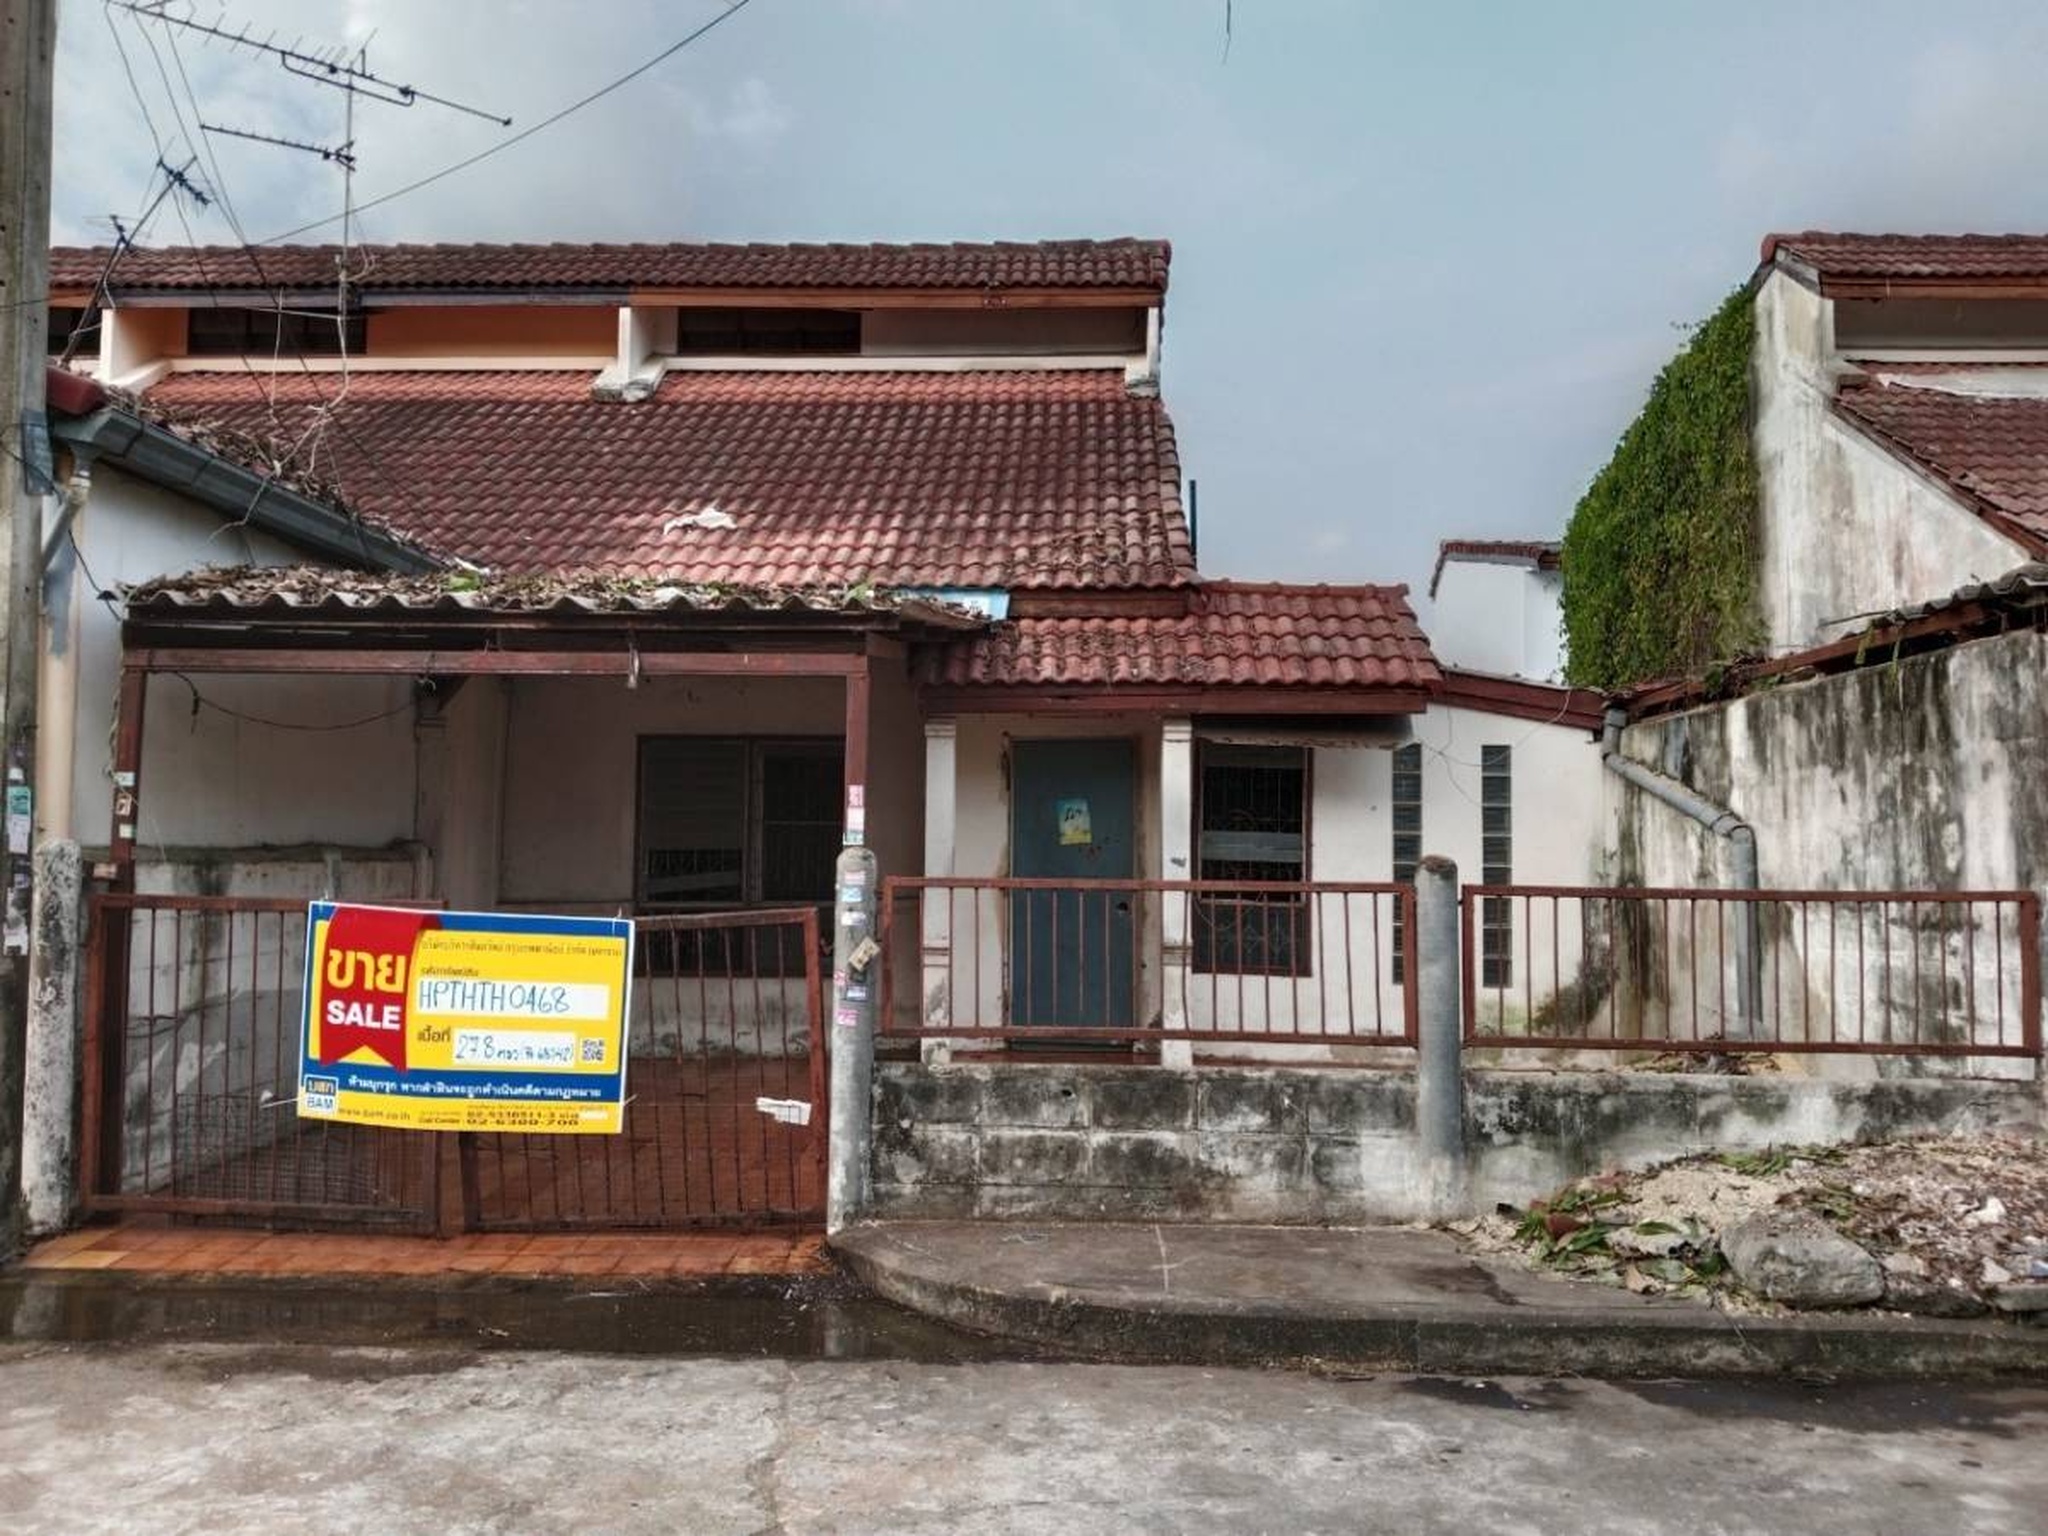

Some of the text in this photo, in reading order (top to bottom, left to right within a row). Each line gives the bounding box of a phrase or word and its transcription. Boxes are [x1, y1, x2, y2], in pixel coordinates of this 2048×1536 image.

[327, 949, 406, 993] ขาย
[327, 1000, 402, 1030] SALE
[307, 1096, 334, 1110] BAM
